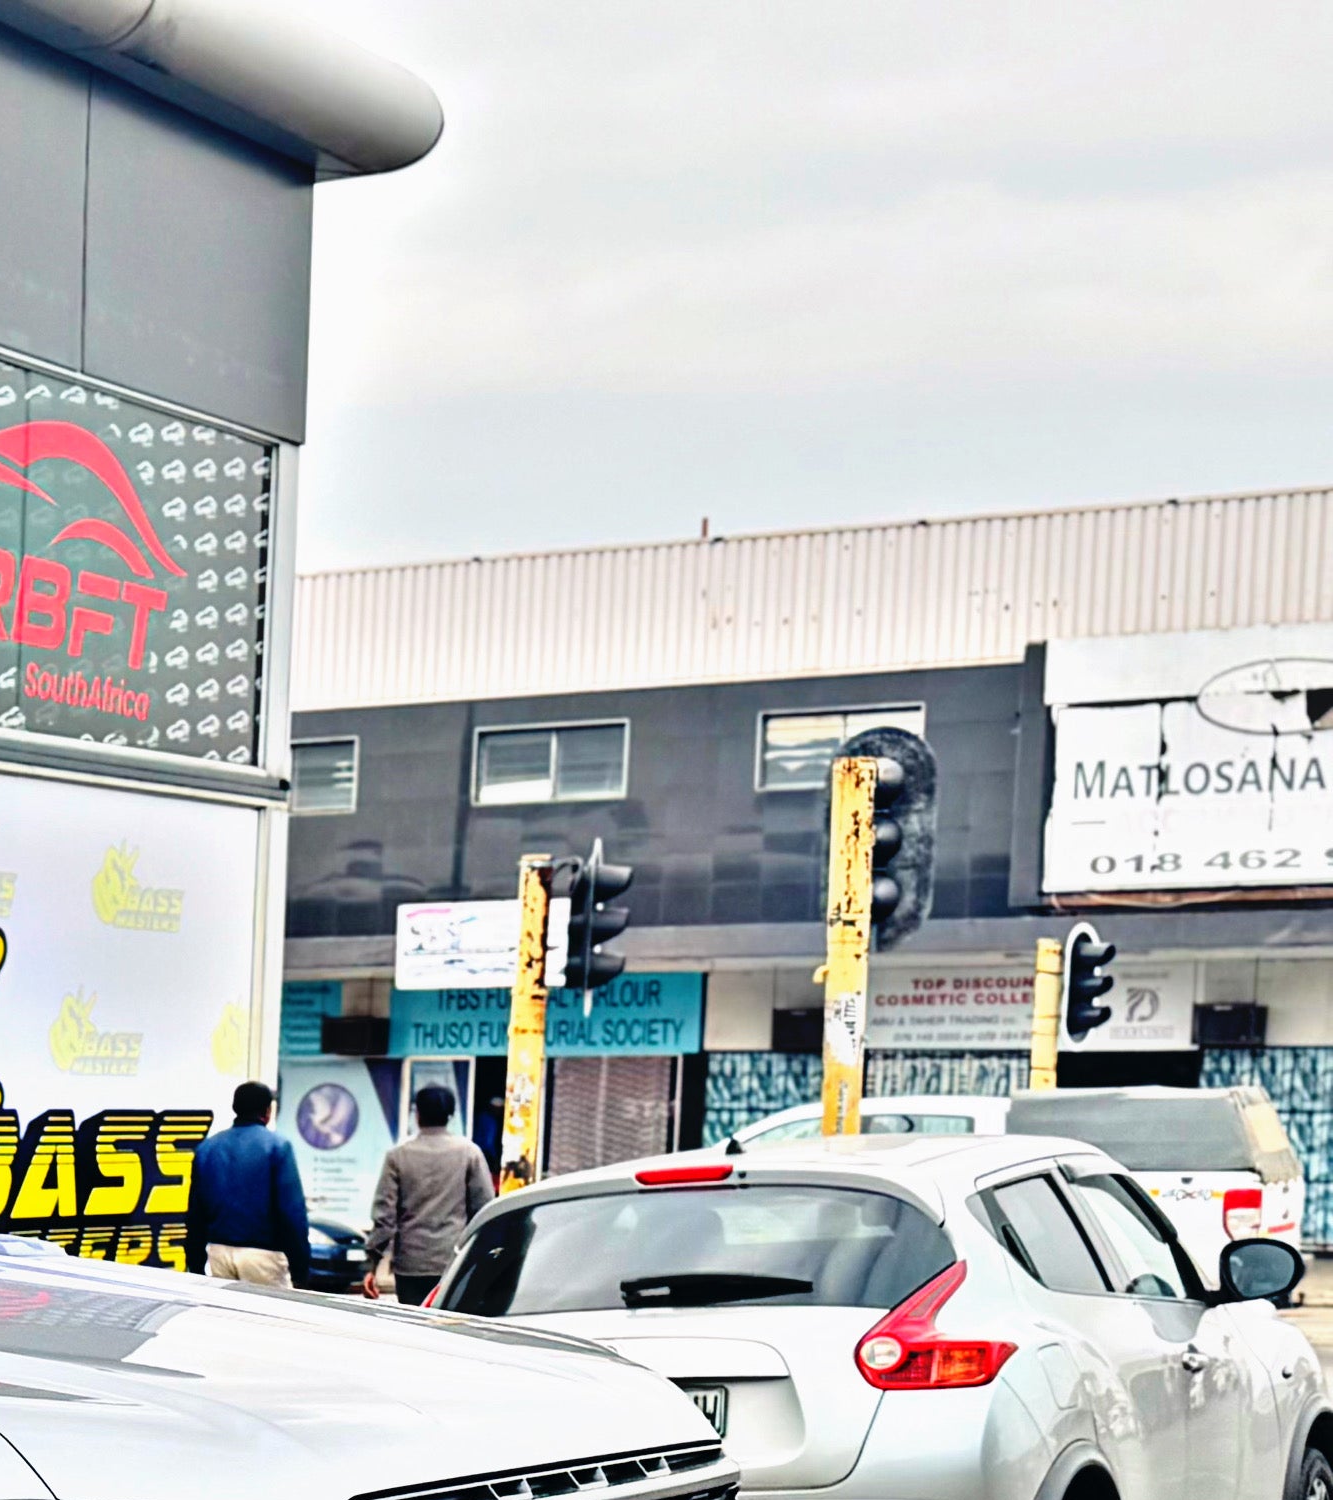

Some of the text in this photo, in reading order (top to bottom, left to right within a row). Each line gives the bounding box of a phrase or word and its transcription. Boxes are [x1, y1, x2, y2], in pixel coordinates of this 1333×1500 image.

[1090, 852, 1182, 875] 018
[1204, 848, 1302, 871] 462
[912, 976, 1033, 990] TOP DISCOUN
[875, 992, 1032, 1007] COSMETIC COLLE
[413, 1021, 475, 1049] THUSO
[543, 1019, 597, 1047] URIAL
[601, 1018, 684, 1047] SOCIETY
